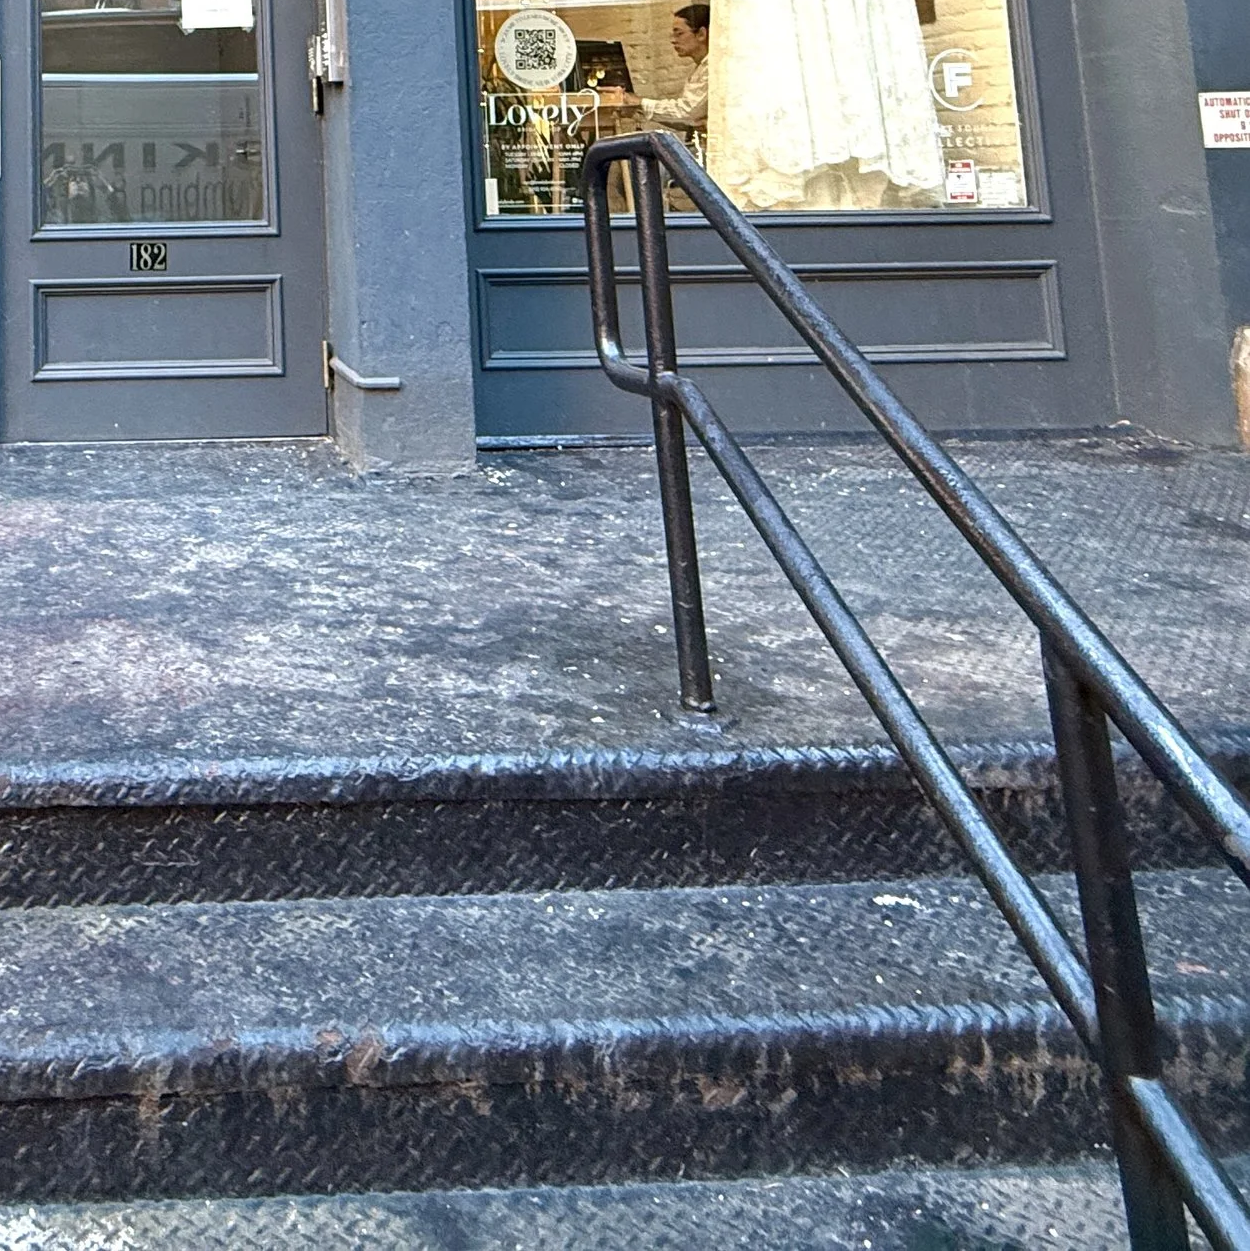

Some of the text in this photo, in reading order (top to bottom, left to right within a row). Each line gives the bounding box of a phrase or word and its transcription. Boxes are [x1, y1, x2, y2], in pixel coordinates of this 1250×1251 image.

[488, 88, 601, 137] Lovely
[1219, 109, 1240, 119] SHUT
[512, 143, 563, 151] APPOINMENT
[131, 243, 167, 271] 182
